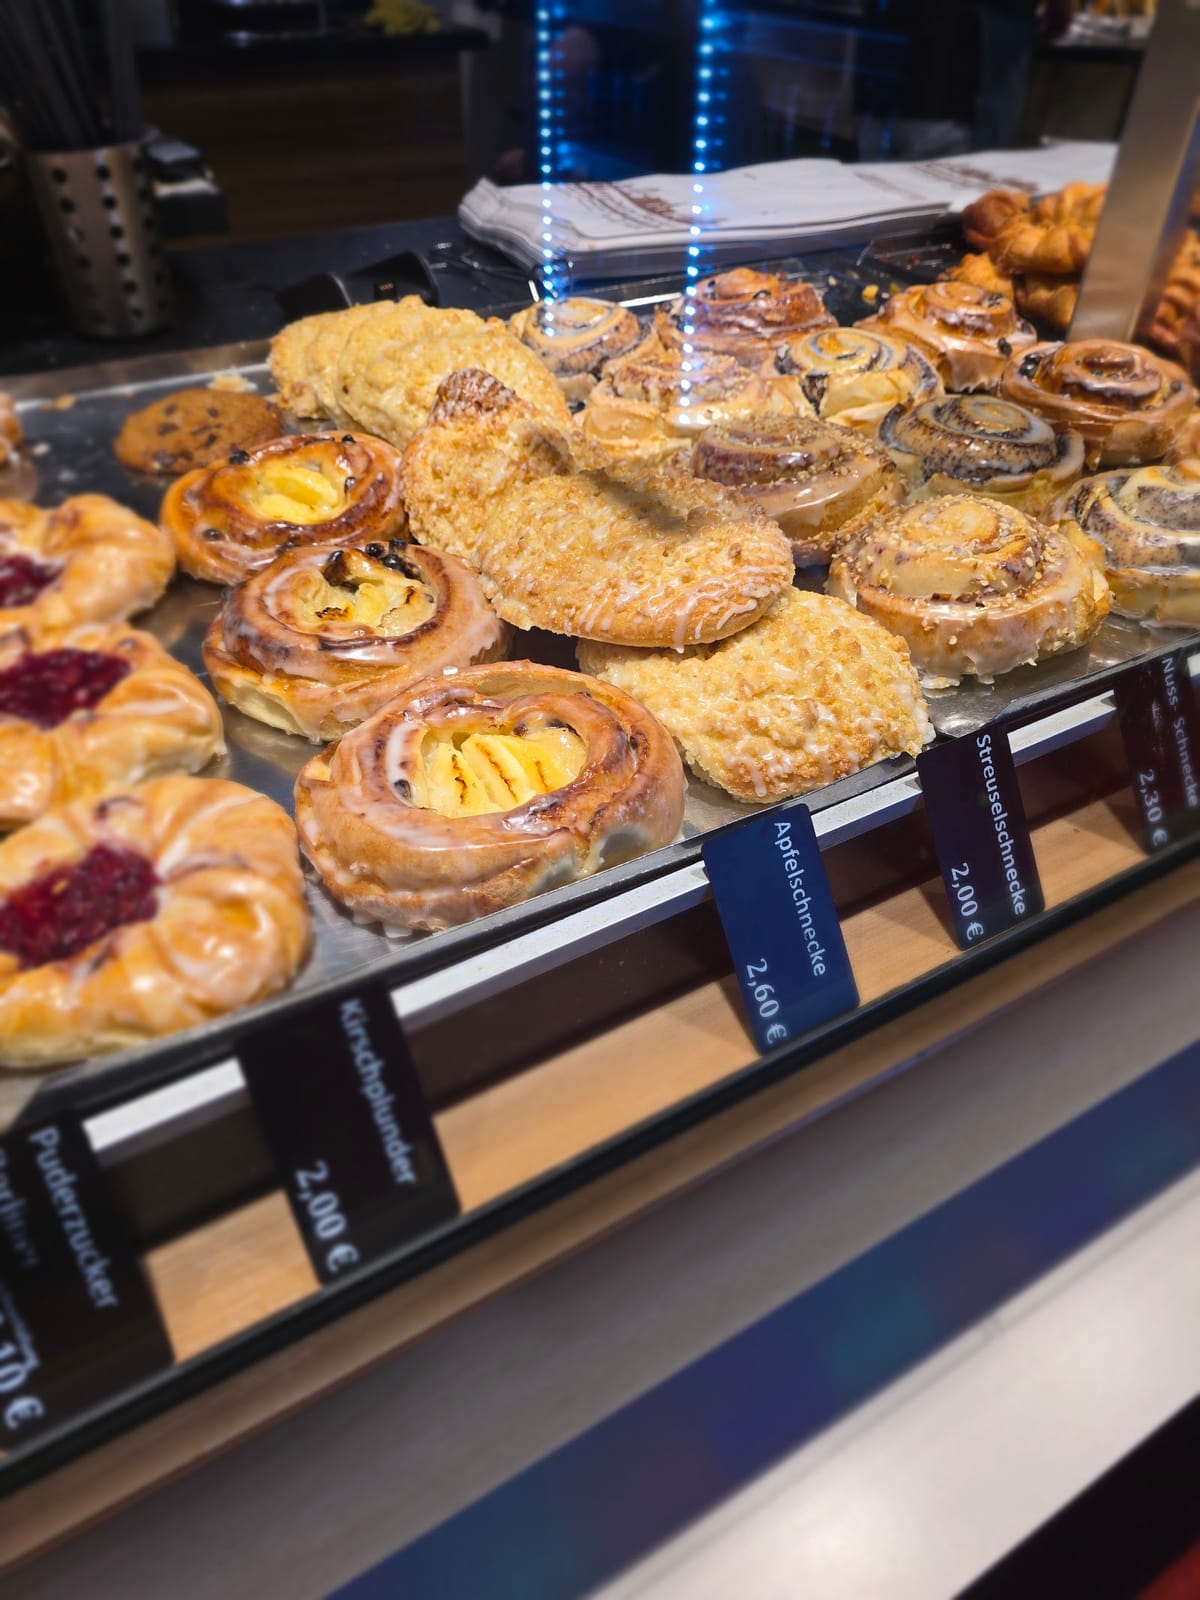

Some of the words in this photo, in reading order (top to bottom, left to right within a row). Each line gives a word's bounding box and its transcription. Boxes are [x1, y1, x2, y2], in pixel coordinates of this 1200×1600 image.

[1161, 656, 1179, 712] Nuss-
[1173, 716, 1199, 808] Schnecke
[976, 733, 1026, 915] Streuselschnecke
[1138, 768, 1164, 824] 2,30
[1152, 828, 1169, 847] €
[774, 822, 827, 976] Apfelschnecke
[951, 861, 979, 917] 2,00
[966, 921, 985, 941] €
[746, 957, 780, 1018] 2,60
[766, 1023, 788, 1044] €
[339, 999, 416, 1184] Kirschplunder
[28, 1126, 119, 1308] Puderzucker
[296, 1159, 347, 1240] 2,00
[326, 1242, 359, 1272] €
[4, 1395, 44, 1430] €
